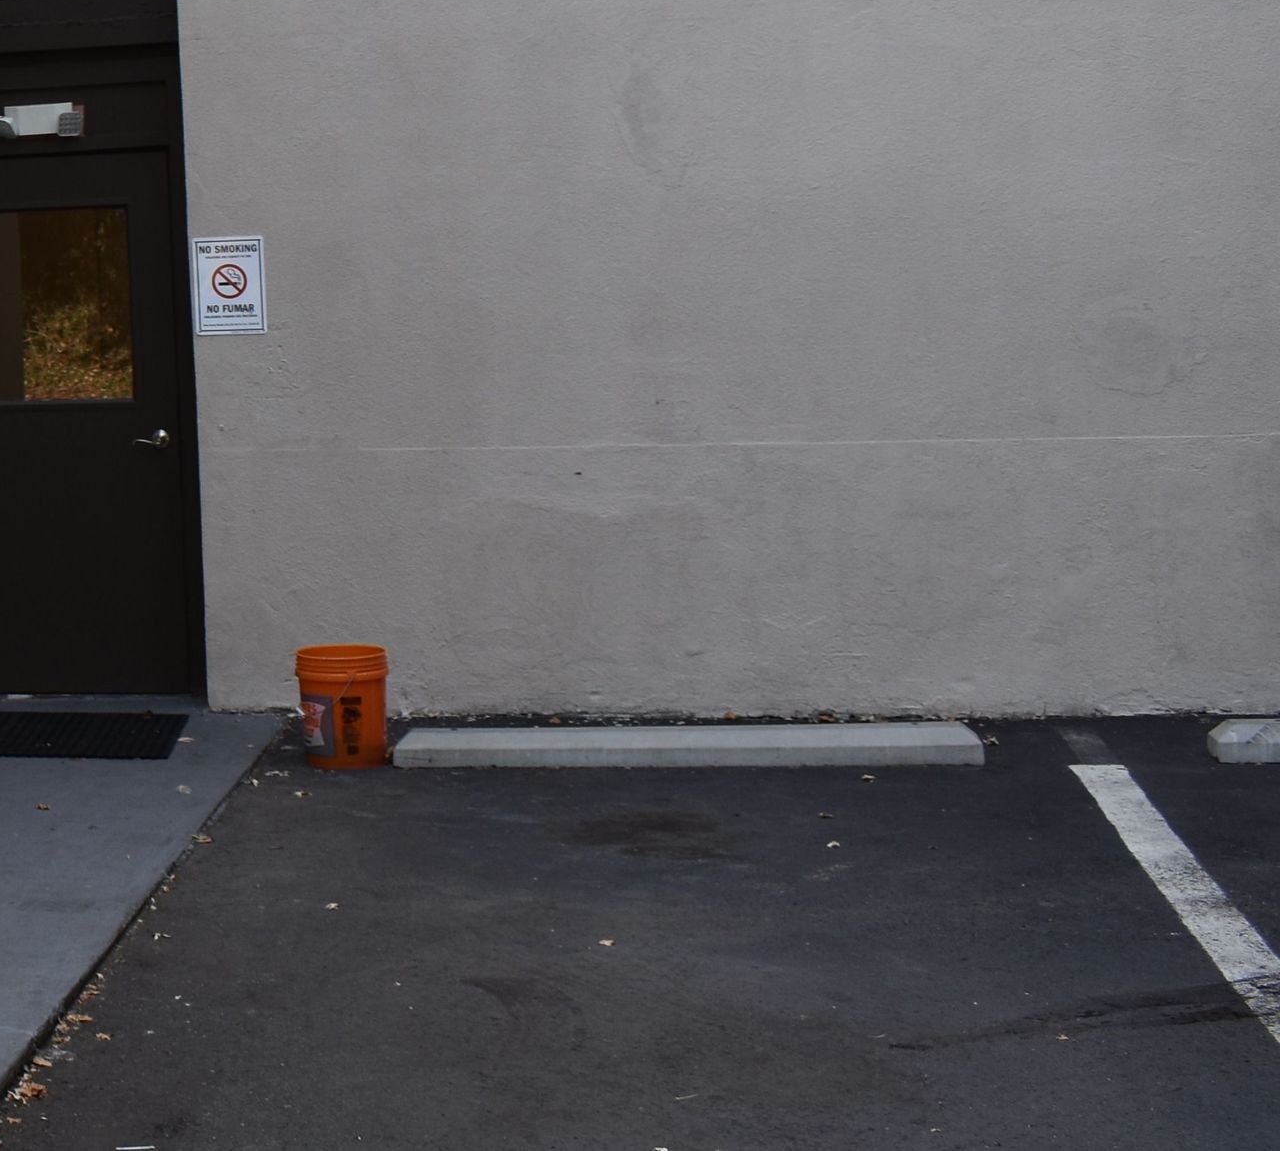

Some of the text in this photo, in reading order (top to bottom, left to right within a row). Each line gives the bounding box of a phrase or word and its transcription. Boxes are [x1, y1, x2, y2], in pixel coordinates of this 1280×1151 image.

[199, 244, 257, 254] NO SMOKING
[206, 303, 255, 313] NO FUMAR
